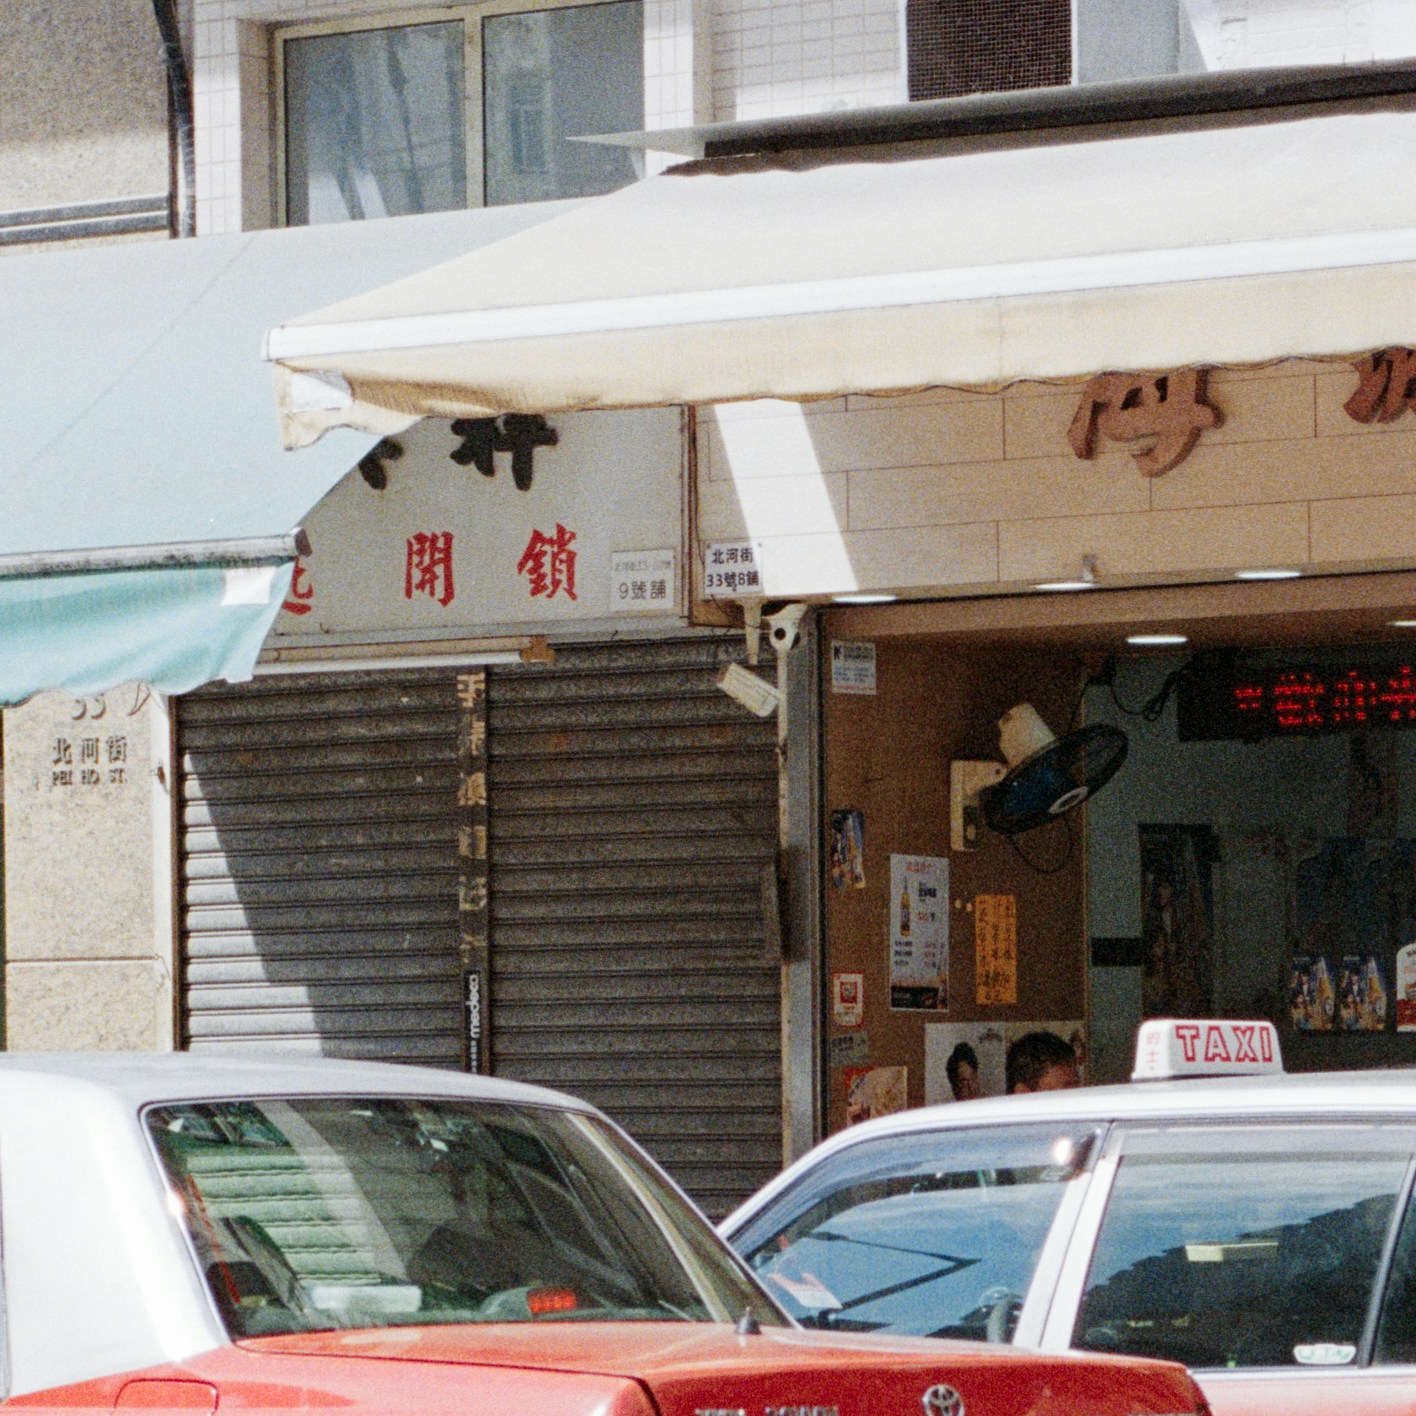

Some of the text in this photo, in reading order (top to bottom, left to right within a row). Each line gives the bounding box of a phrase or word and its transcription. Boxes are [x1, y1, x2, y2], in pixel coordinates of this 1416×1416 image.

[711, 547, 754, 565] 北河街
[52, 735, 128, 765] 北河街
[1174, 1024, 1274, 1063] TAXI
